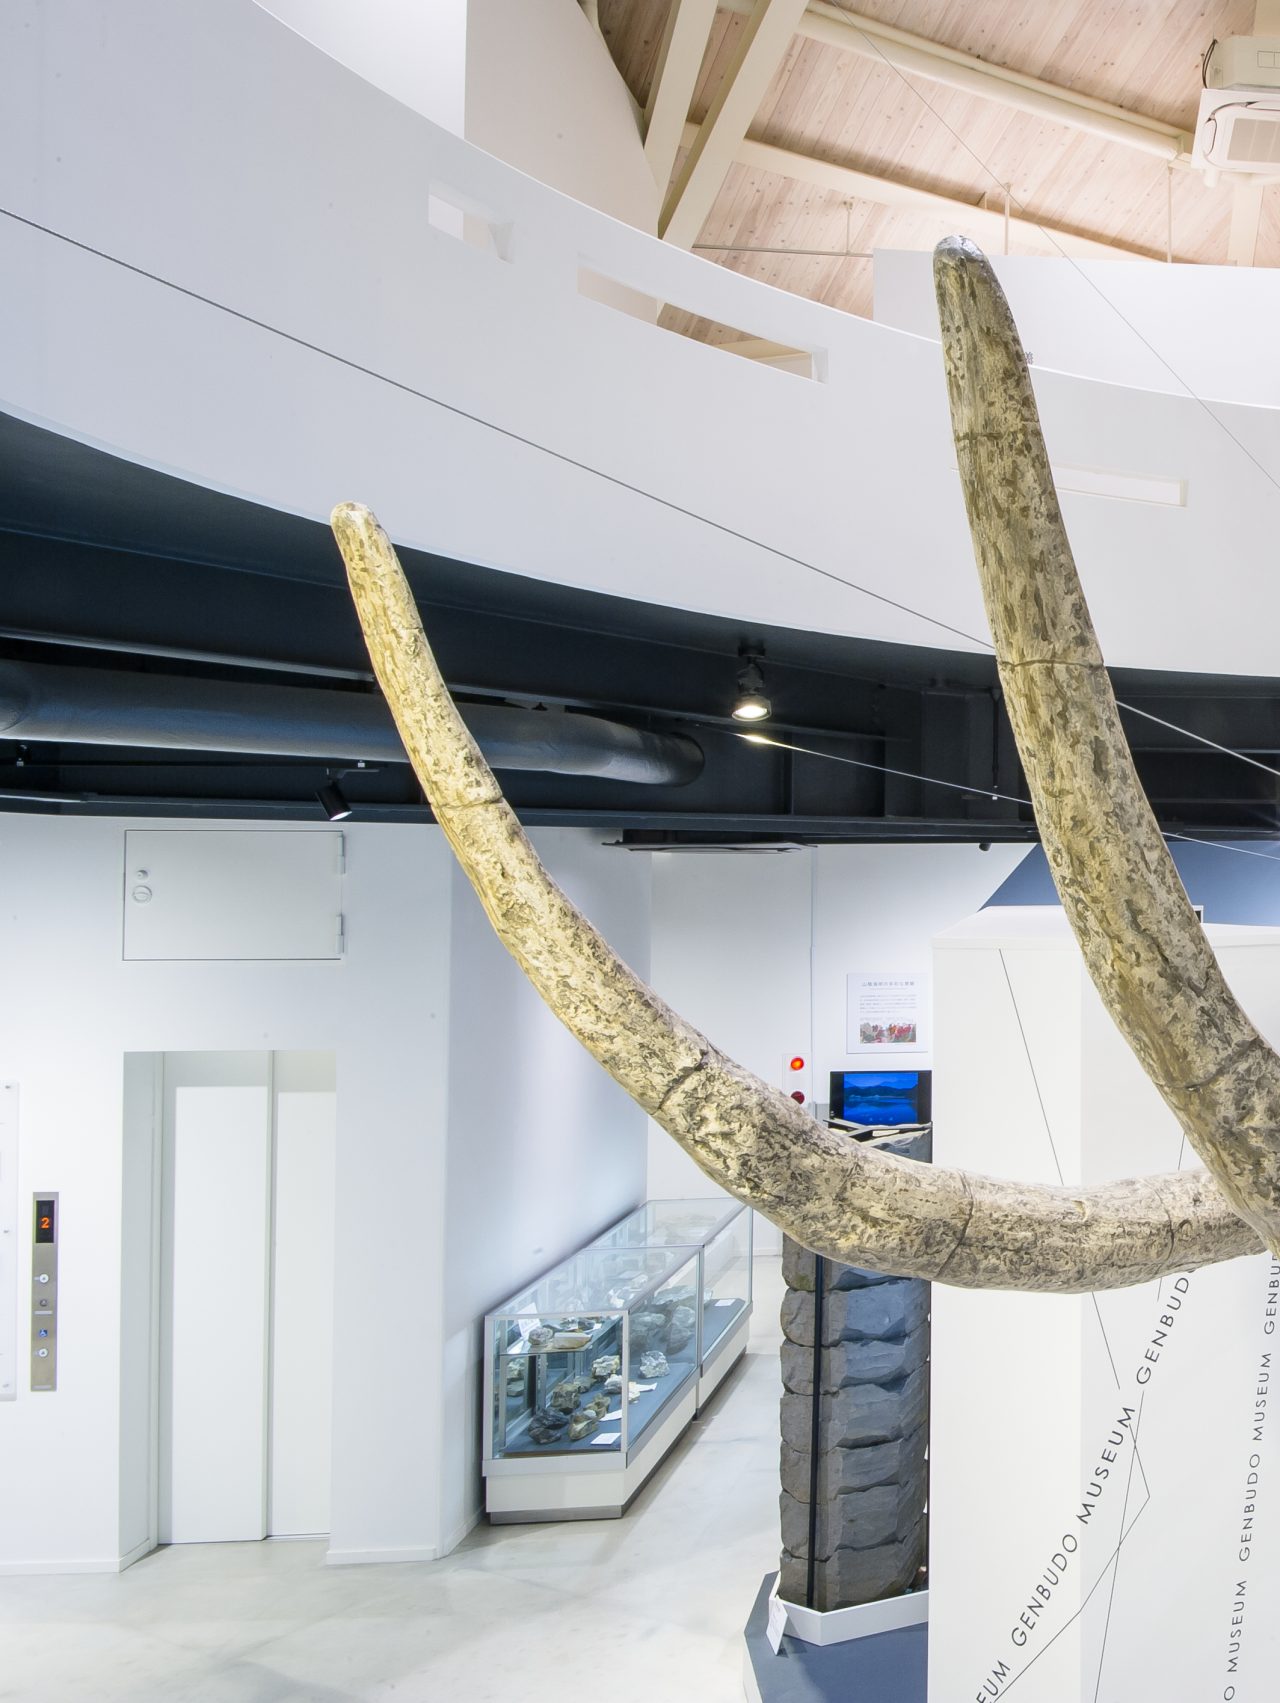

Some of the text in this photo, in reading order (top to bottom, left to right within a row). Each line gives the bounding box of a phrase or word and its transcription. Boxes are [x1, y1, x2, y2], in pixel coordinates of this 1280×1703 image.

[41, 1217, 50, 1229] 2
[976, 1272, 1192, 1703] EUM GENBUDO MUSEUM GENBUD
[1227, 1580, 1249, 1674] MUSEUM
[1238, 1453, 1262, 1563] GENBUDO
[1251, 1352, 1273, 1441] MUSEUM
